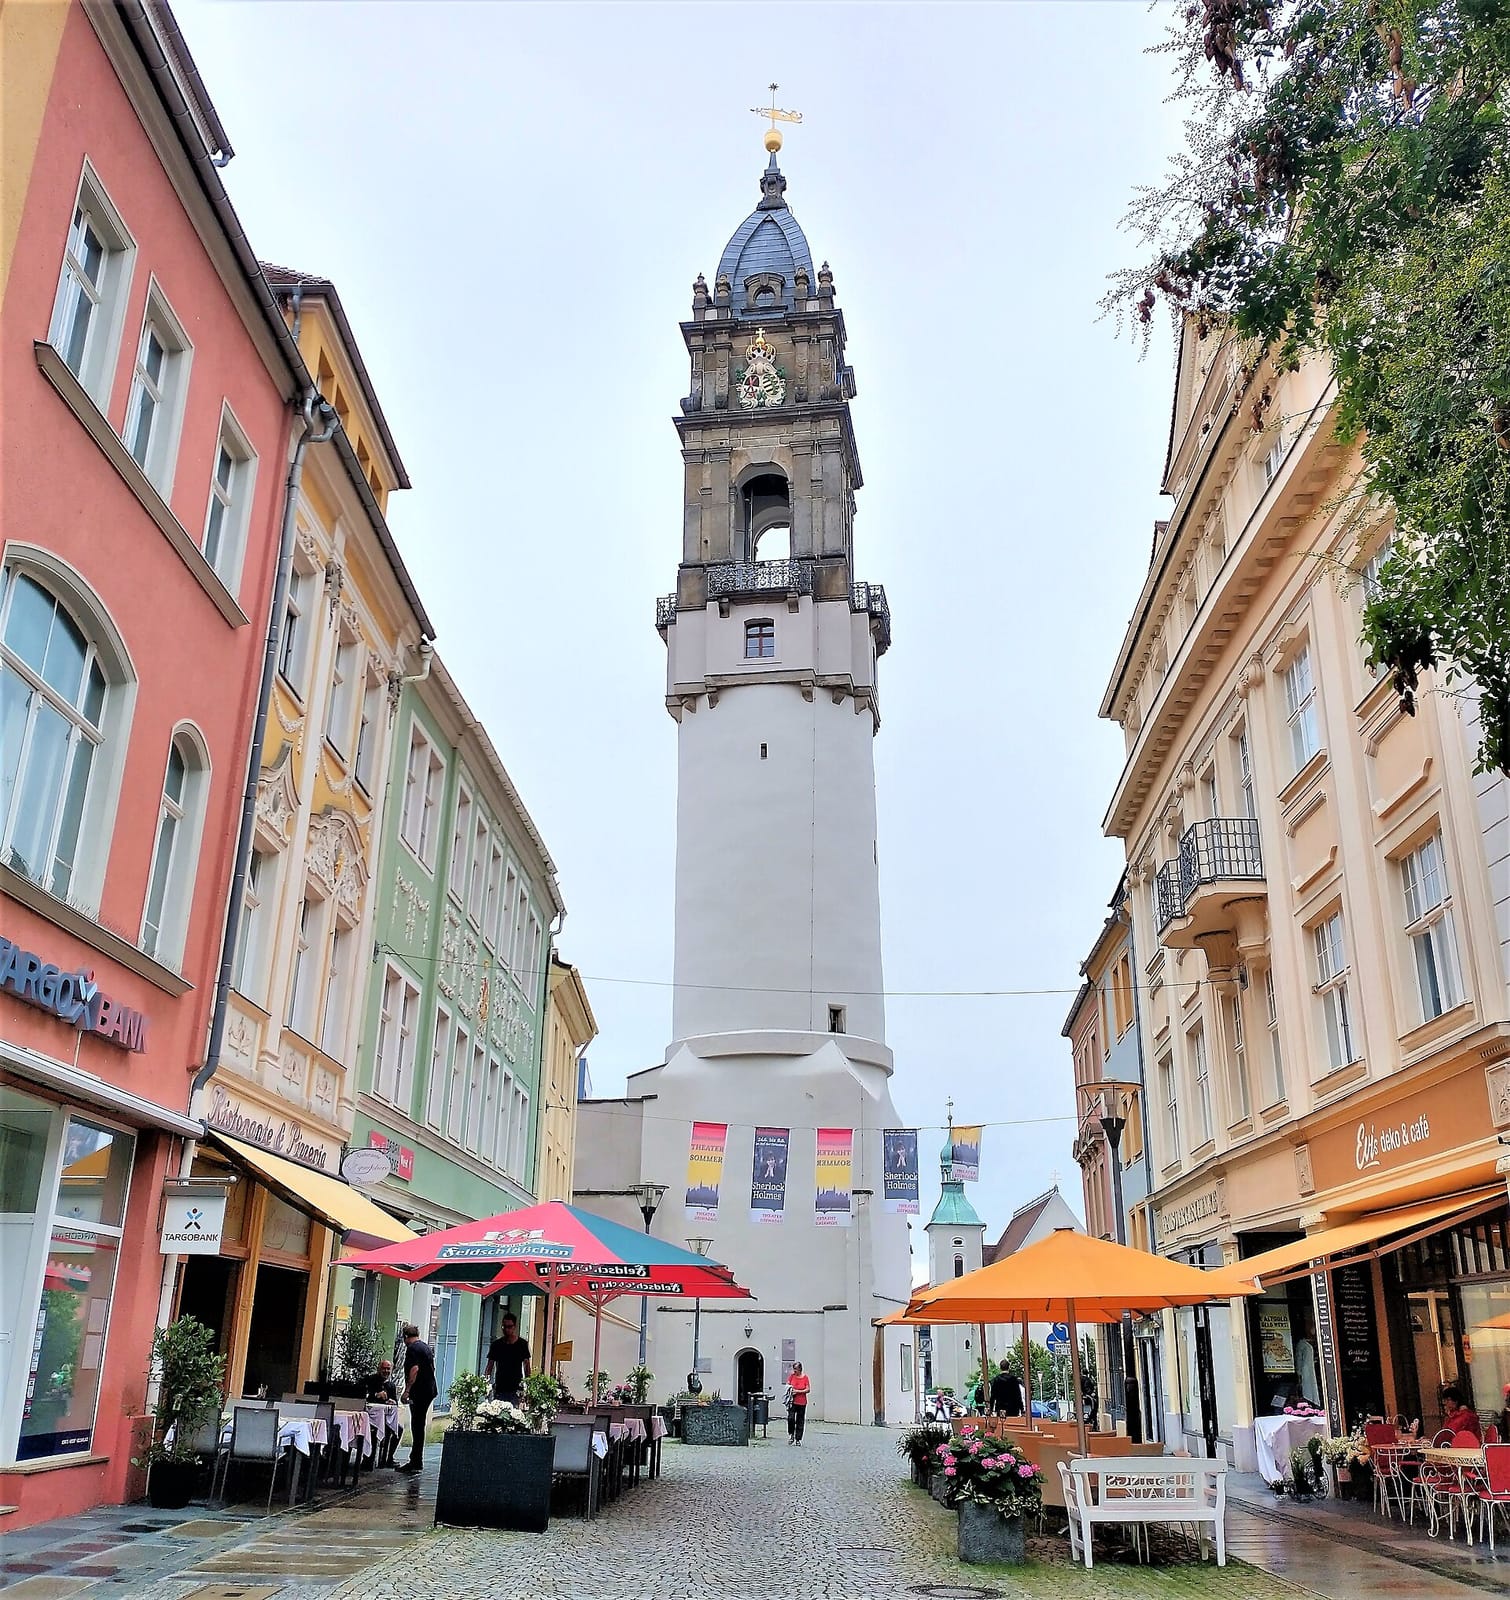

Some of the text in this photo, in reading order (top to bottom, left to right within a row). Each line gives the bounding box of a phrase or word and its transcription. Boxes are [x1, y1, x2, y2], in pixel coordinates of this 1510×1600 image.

[208, 1084, 328, 1169] Ristorante & Pizzeria
[1380, 1128, 1400, 1153] deko
[1401, 1122, 1410, 1146] &
[1410, 1113, 1430, 1143] café
[691, 1143, 724, 1153] THEATER
[689, 1154, 723, 1164] SOMMER
[884, 1172, 918, 1181] Sherlock
[752, 1181, 785, 1191] Sherlock
[887, 1181, 917, 1190] Holmes
[753, 1190, 782, 1201] Holmes
[164, 1233, 219, 1242] TARGOBANK
[442, 1244, 570, 1258] Feldschlößchen
